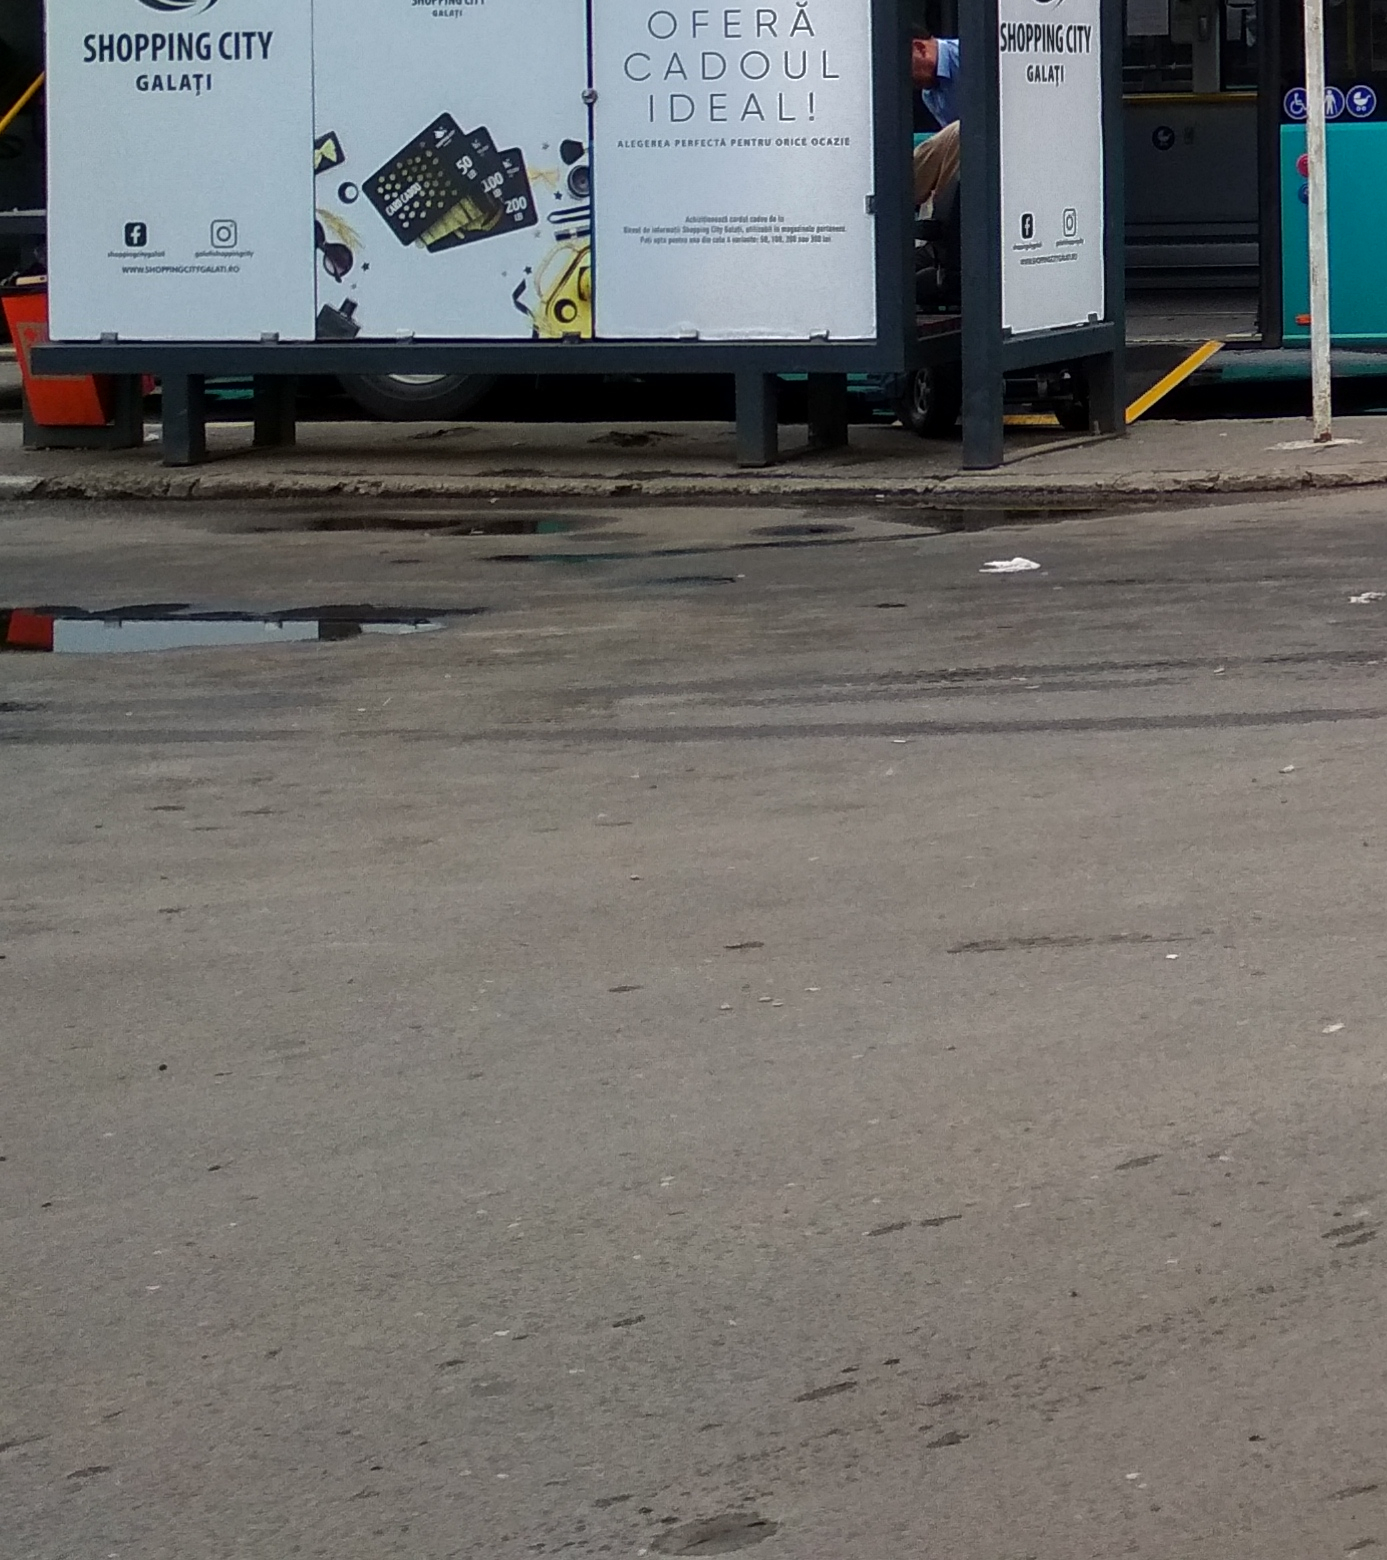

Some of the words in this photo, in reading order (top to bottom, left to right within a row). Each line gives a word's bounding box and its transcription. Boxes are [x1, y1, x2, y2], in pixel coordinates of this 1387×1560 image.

[647, 1, 815, 40] OFERĂ
[83, 31, 212, 63] SHOPPING
[218, 30, 274, 61] CITY
[1000, 22, 1064, 54] SHOPPING
[1065, 24, 1092, 54] CITY
[623, 49, 840, 82] CADOUL
[1026, 64, 1065, 88] GALAȚI
[135, 73, 213, 97] GALAȚI
[649, 91, 816, 123] IDEAL!
[617, 139, 671, 149] ALEGEREA
[730, 137, 772, 148] PENTRU
[774, 137, 808, 147] ORICE
[810, 136, 851, 147] OCAZIE
[455, 155, 474, 175] 50
[480, 171, 504, 193] 100
[504, 195, 528, 214] 200
